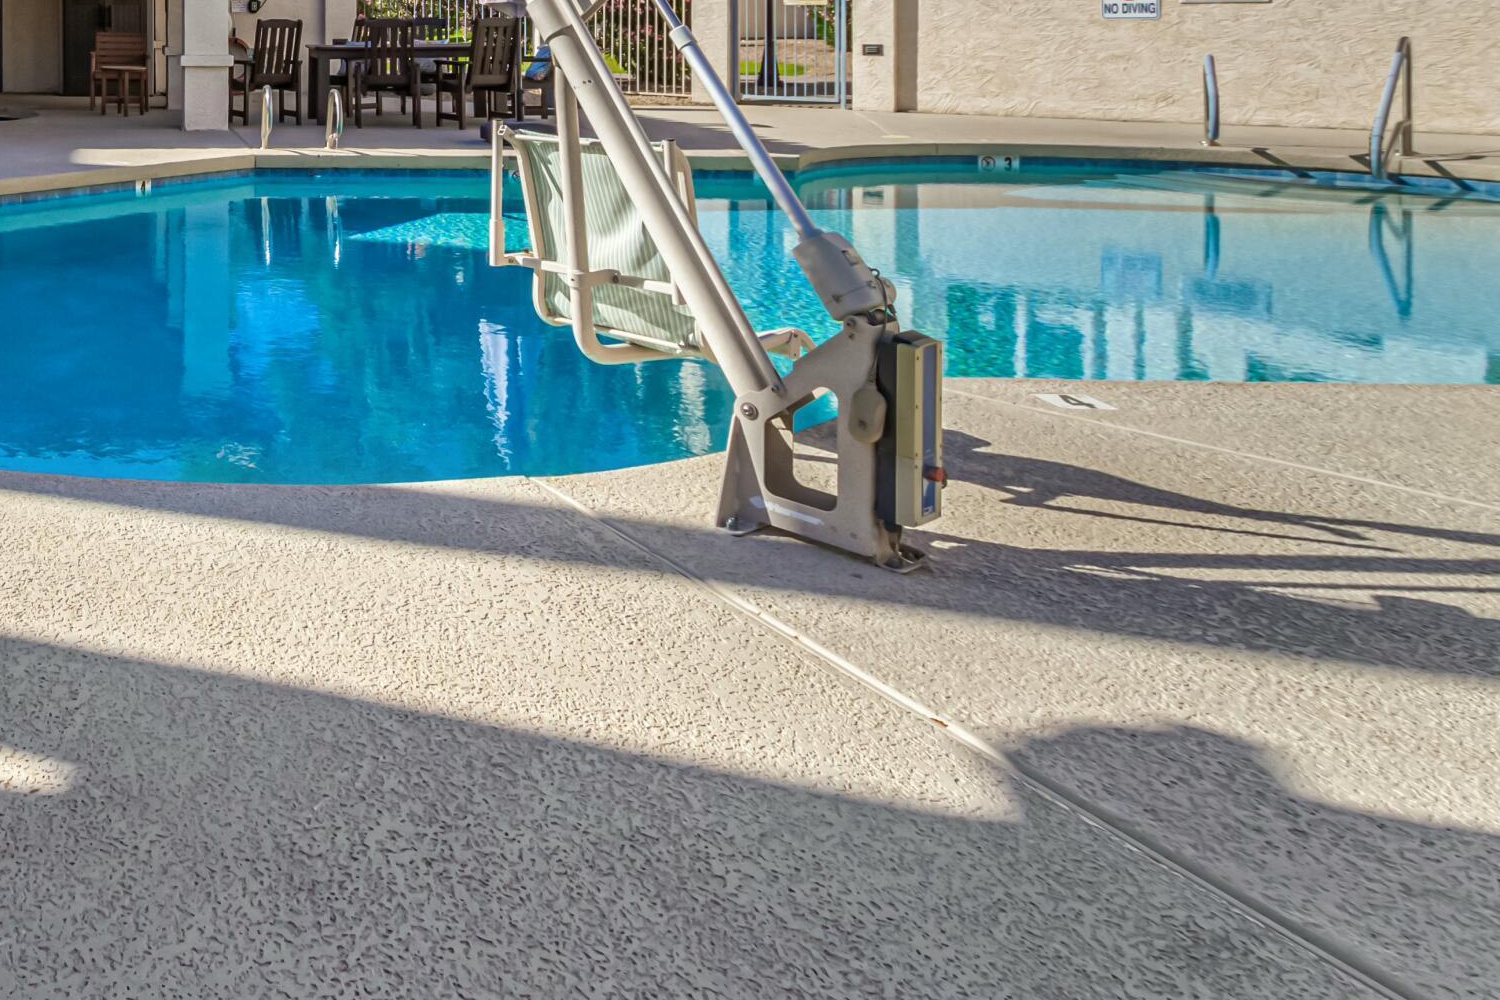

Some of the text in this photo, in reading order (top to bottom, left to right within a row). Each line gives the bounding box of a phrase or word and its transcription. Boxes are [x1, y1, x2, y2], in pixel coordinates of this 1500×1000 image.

[1104, 2, 1156, 14] NO DIVING
[1003, 156, 1013, 171] 3
[1058, 394, 1097, 408] 4
